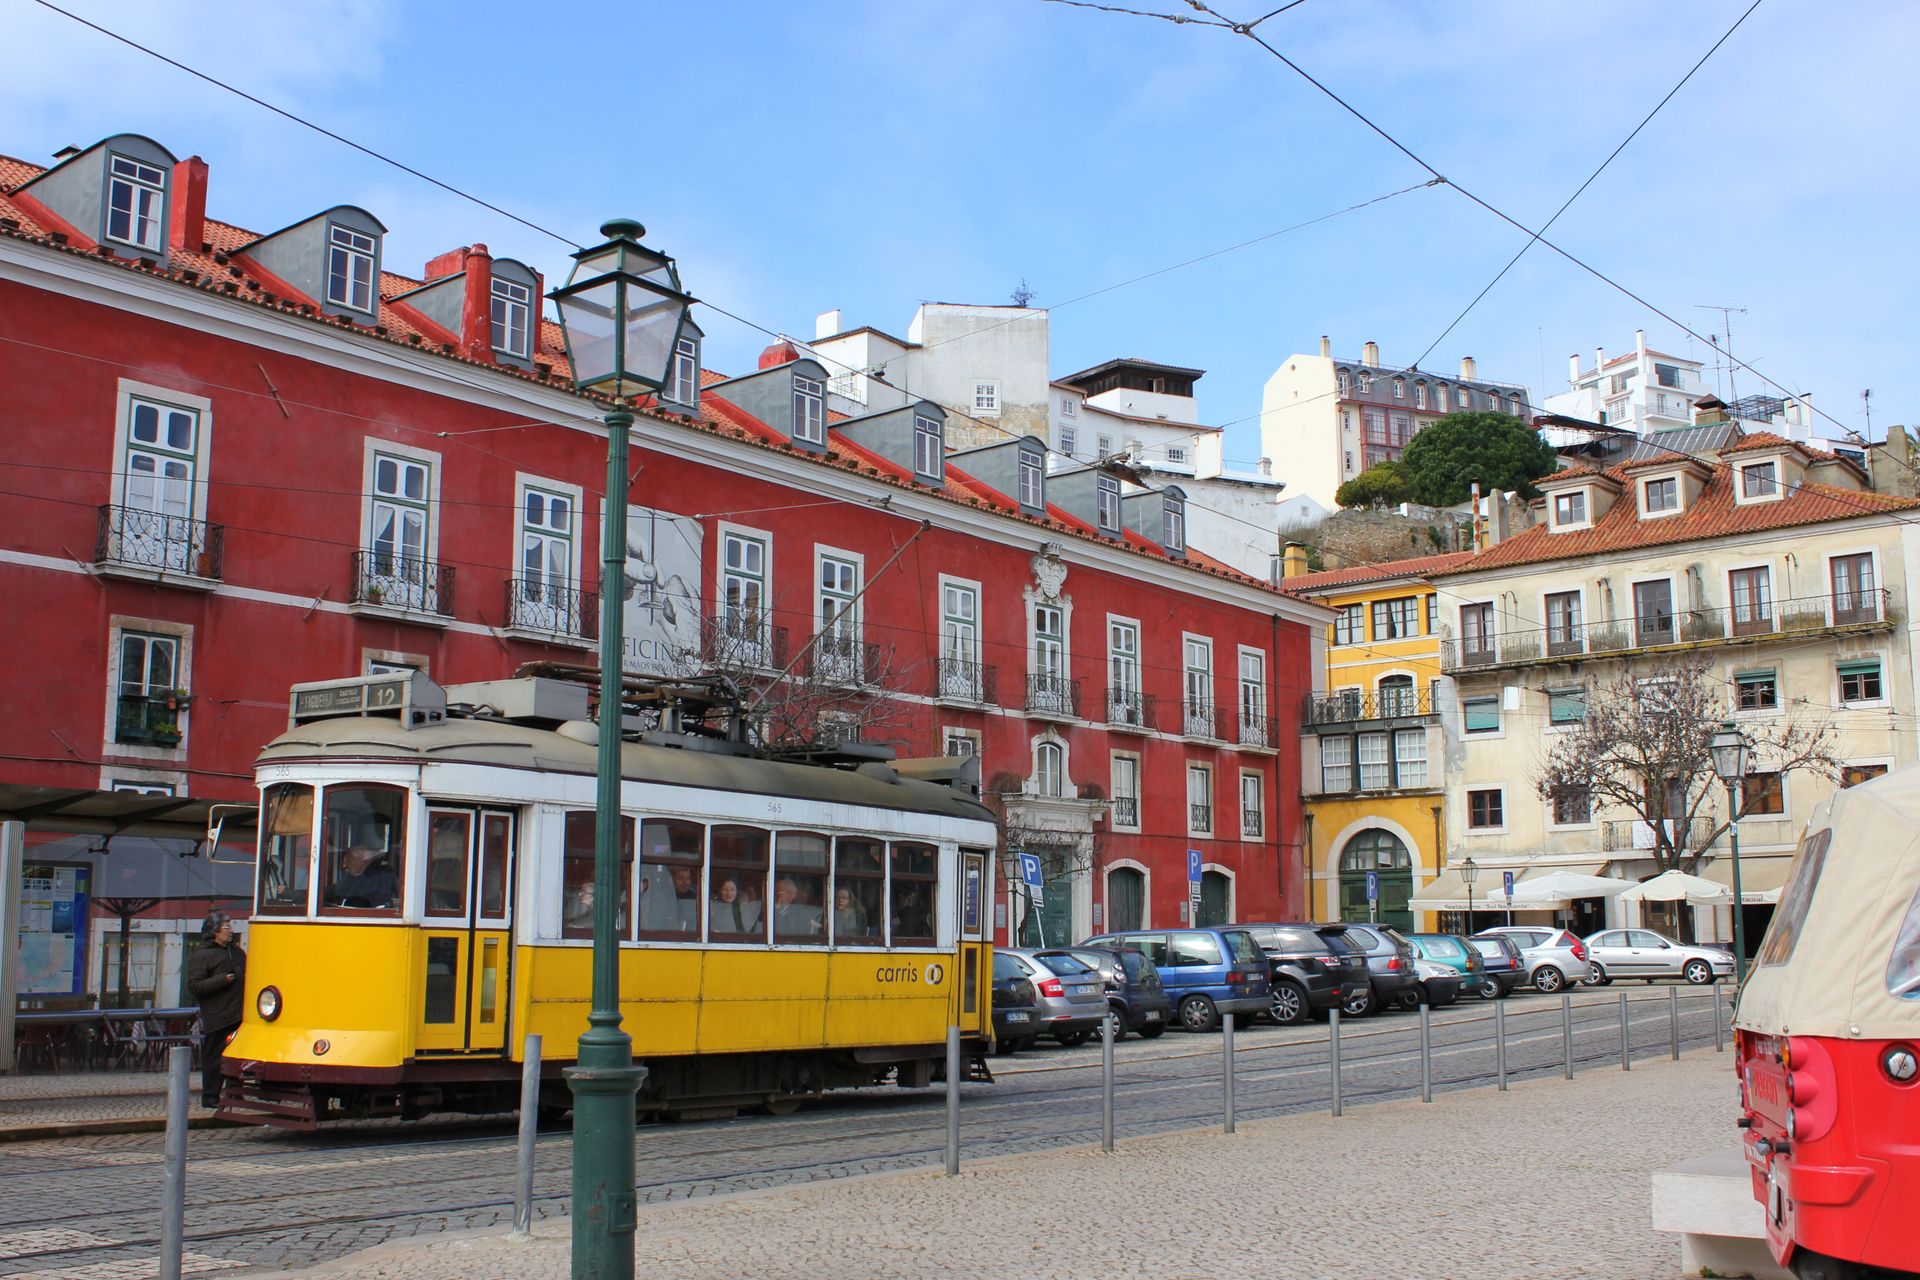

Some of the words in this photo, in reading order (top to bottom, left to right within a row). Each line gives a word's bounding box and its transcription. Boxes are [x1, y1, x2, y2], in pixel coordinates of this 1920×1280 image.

[377, 687, 396, 706] 12
[275, 764, 291, 777] 565
[767, 801, 783, 814] 565
[1024, 858, 1037, 881] P
[1190, 852, 1199, 875] P
[1368, 874, 1376, 897] P
[1505, 873, 1512, 893] P
[876, 962, 918, 983] carris
